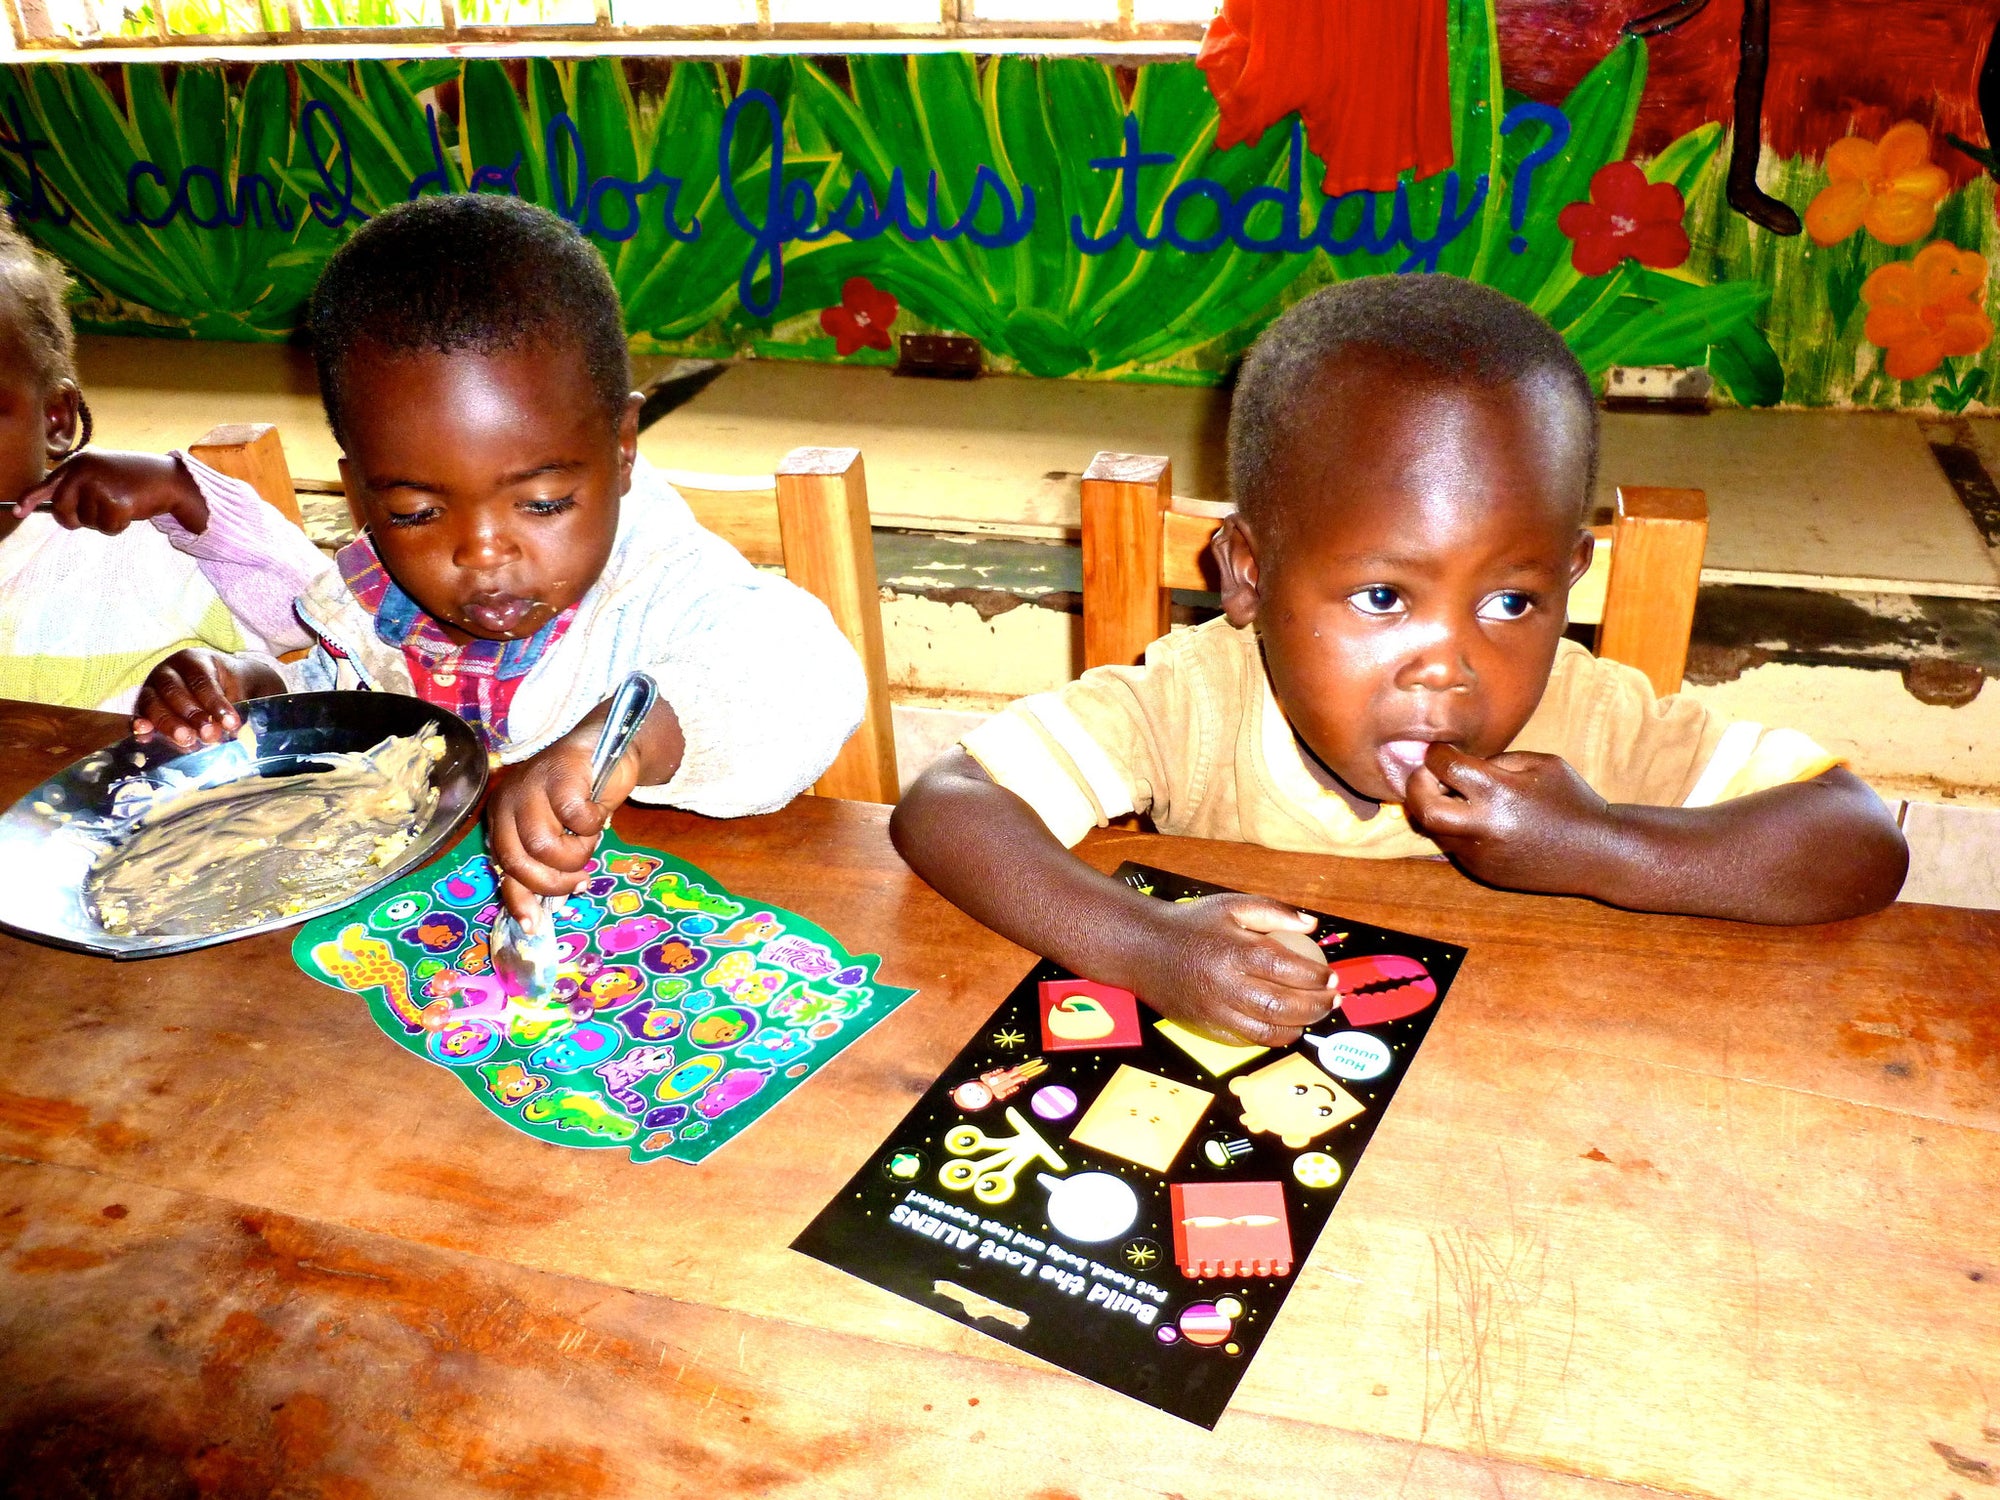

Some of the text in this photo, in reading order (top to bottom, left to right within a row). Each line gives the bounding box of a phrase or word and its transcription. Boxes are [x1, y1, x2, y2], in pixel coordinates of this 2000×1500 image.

[118, 161, 294, 232] can
[302, 100, 370, 229] I
[719, 89, 1037, 318] Jesus
[889, 1204, 1158, 1325] Build the Lost ALIENS
[904, 1189, 1169, 1303] Put head, body and legs together!
